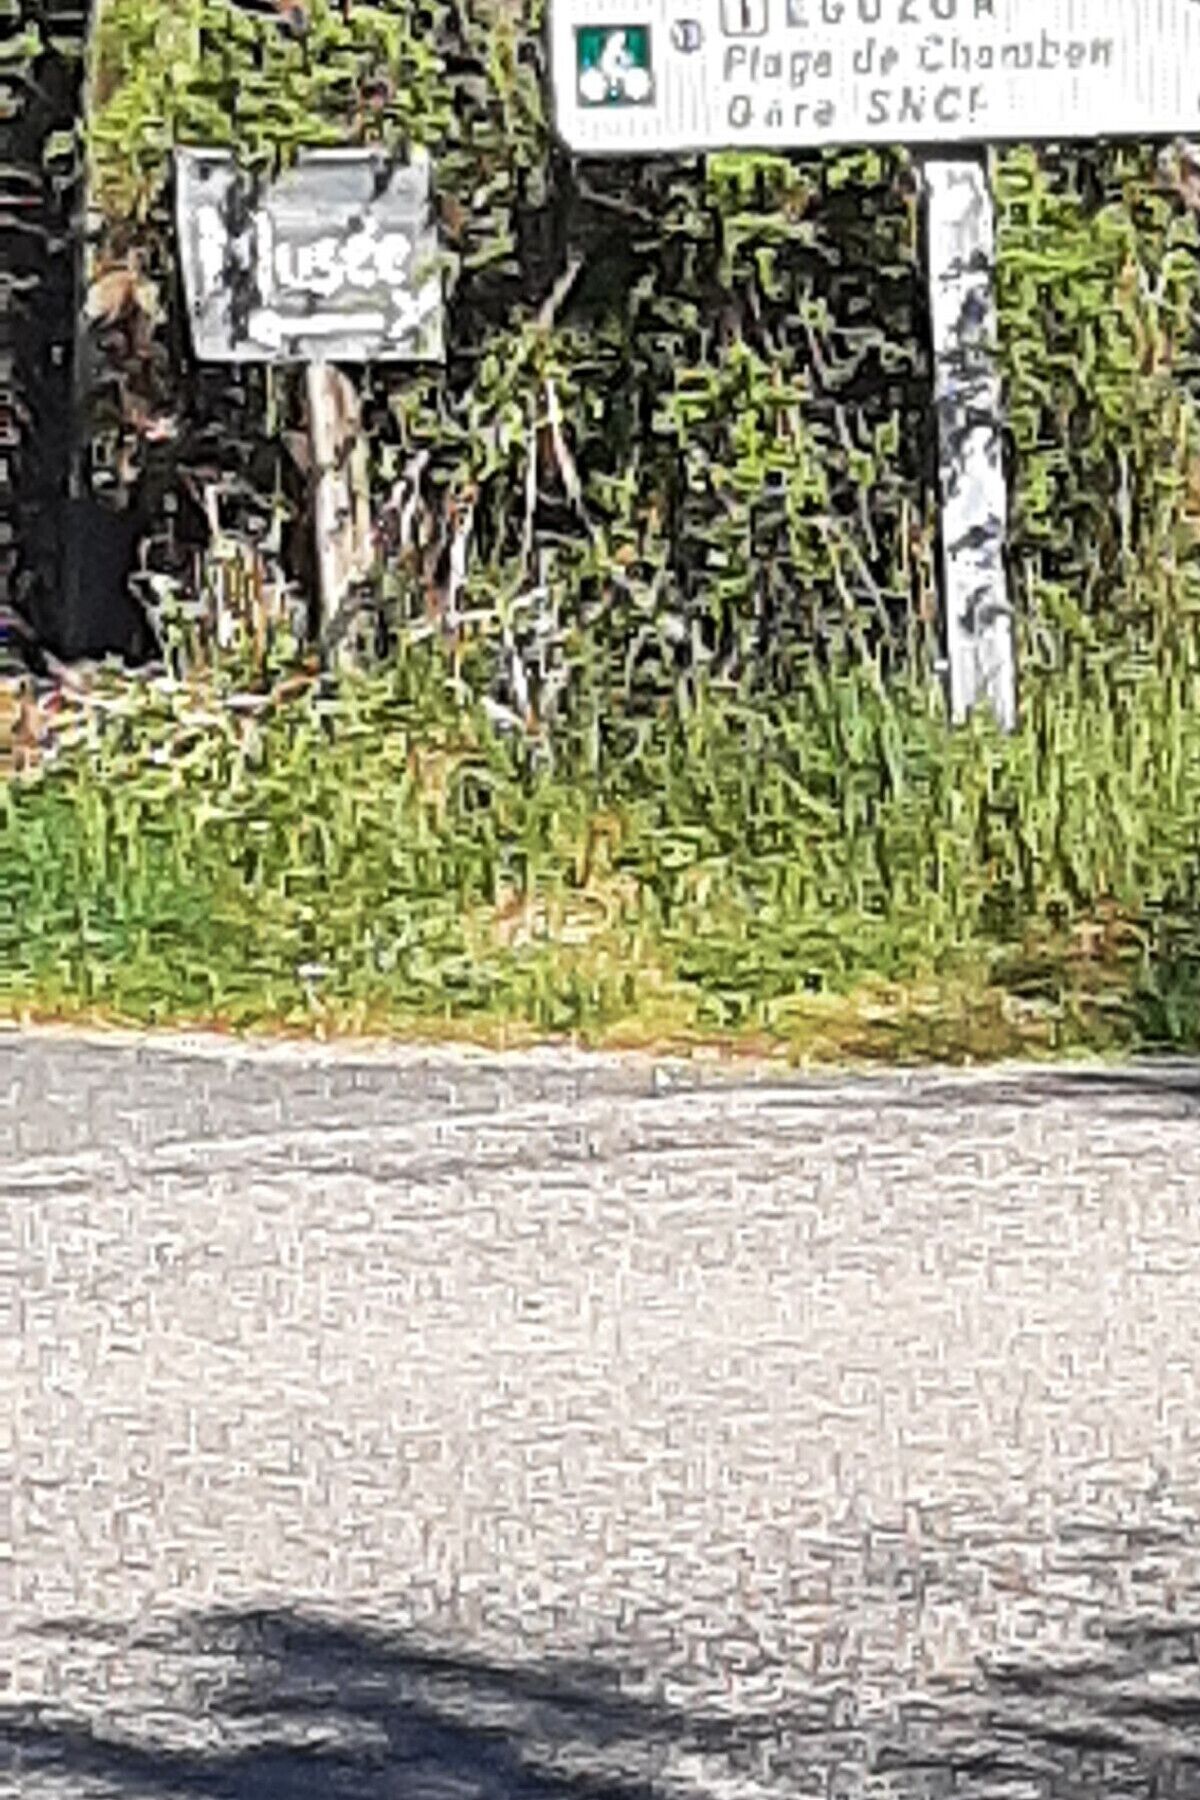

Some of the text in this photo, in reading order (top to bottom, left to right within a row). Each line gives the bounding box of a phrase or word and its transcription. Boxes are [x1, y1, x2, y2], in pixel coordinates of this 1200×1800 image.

[722, 43, 833, 89] Plage
[853, 36, 900, 75] de
[727, 93, 837, 129] Gare
